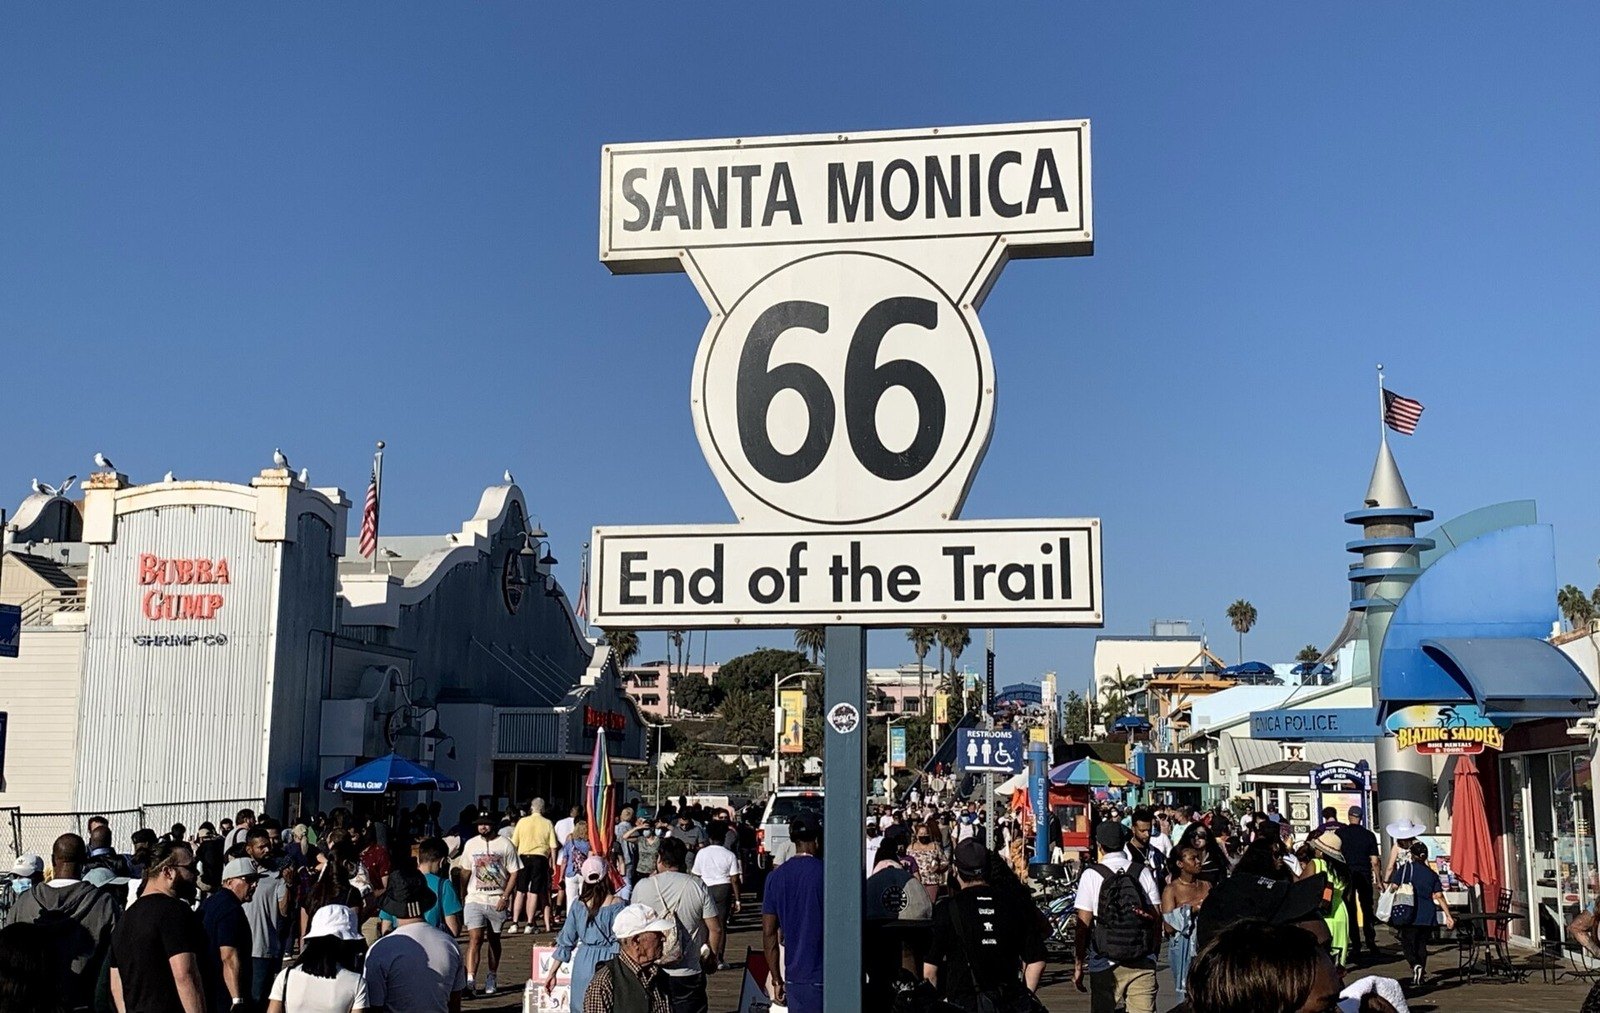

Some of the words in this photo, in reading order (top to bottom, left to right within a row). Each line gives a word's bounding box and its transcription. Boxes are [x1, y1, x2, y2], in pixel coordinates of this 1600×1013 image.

[623, 162, 802, 231] SANTA
[828, 148, 1068, 223] MONICA
[736, 296, 946, 483] 66
[139, 553, 230, 585] BUBBA
[619, 543, 724, 605] End
[749, 542, 807, 604] of
[829, 541, 920, 602] the
[943, 538, 1071, 601] Trail
[143, 590, 224, 621] GUMP
[133, 634, 199, 647] SHRIMP
[1285, 714, 1338, 731] POLICE
[966, 730, 1013, 739] RESTROOMS
[1398, 727, 1448, 750] BLAZING
[1451, 727, 1501, 748] SADDLES
[1156, 758, 1201, 780] BAR
[1317, 767, 1337, 779] SANTA
[1337, 767, 1362, 779] MONICA
[344, 780, 366, 789] BUBBA
[366, 781, 383, 789] GUMP
[1036, 777, 1045, 826] Emergency
